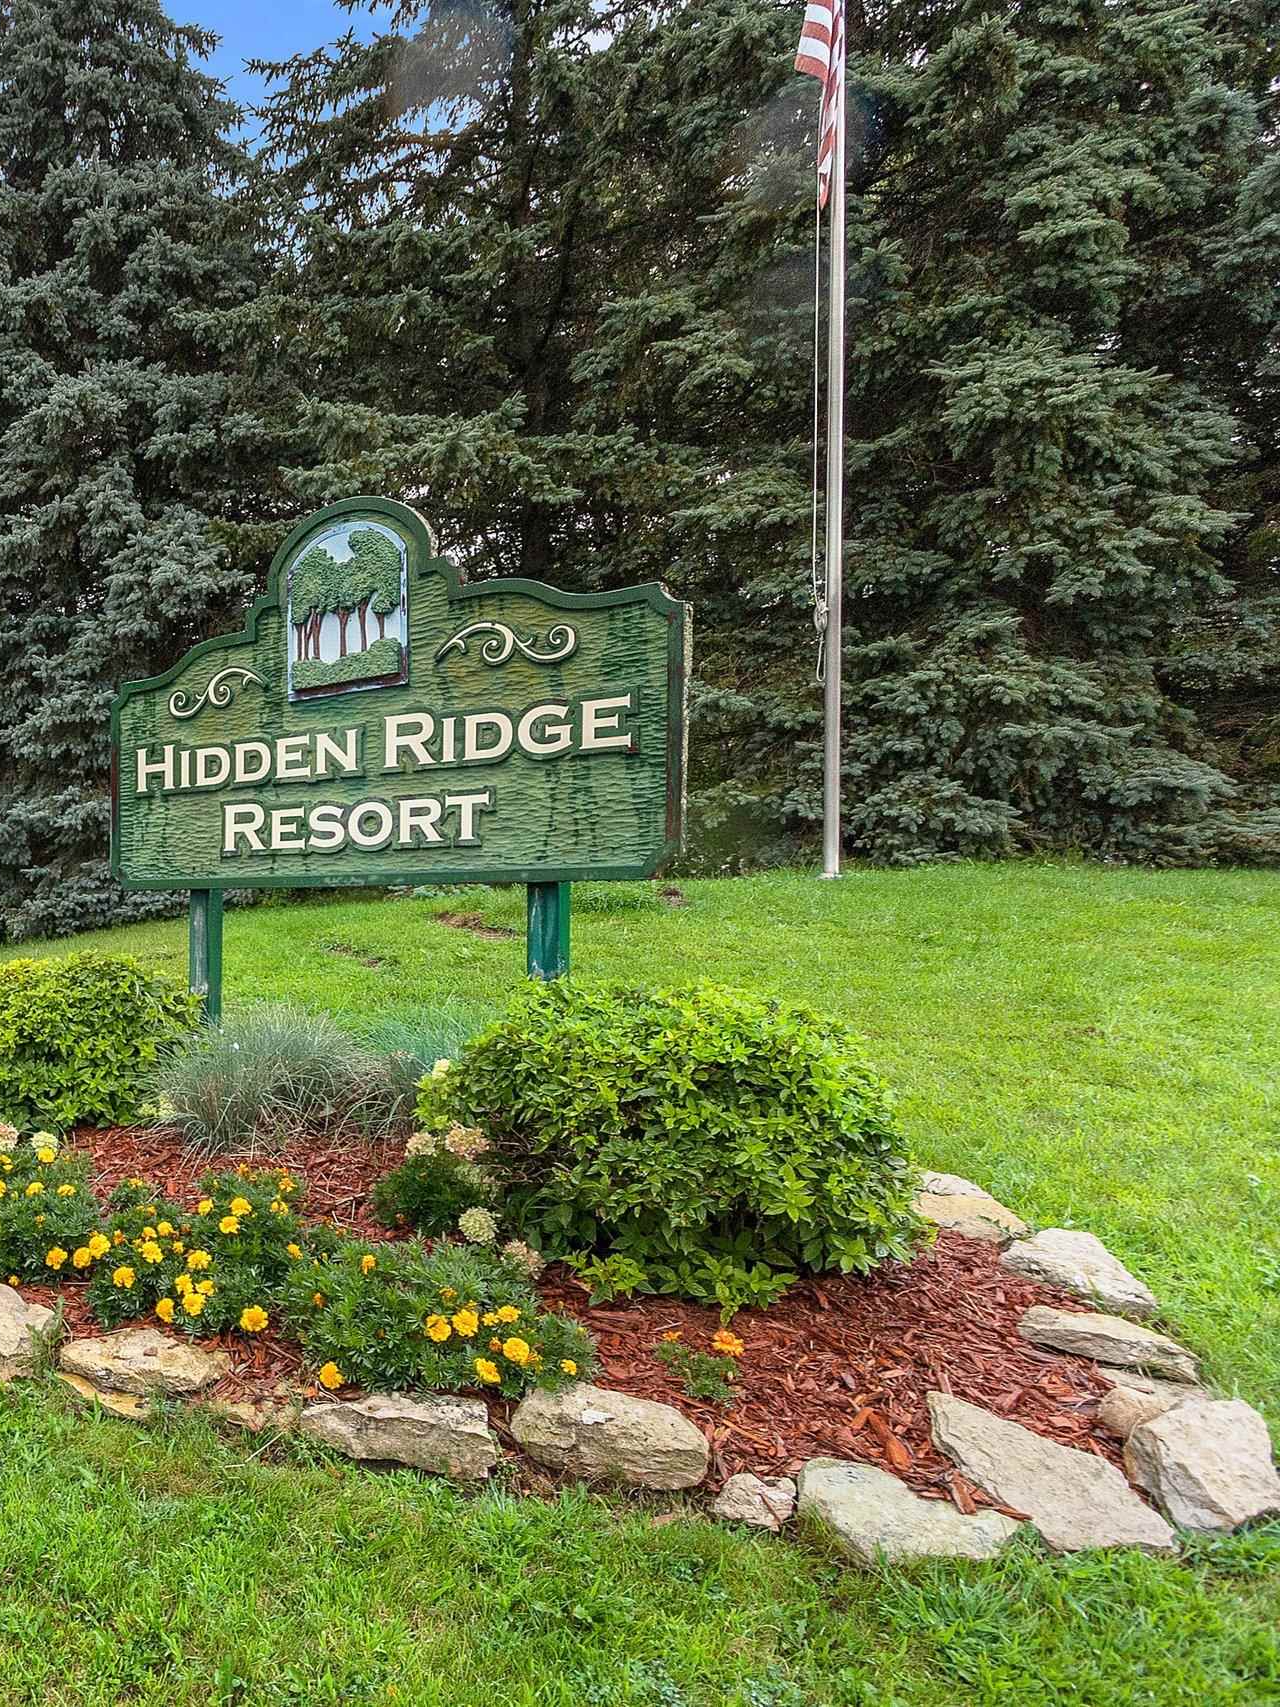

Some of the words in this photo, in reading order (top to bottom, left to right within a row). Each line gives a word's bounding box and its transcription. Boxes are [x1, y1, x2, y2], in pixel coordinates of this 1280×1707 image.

[136, 728, 358, 793] HIDDEN
[384, 694, 633, 770] RIDGE
[224, 792, 490, 853] RESORT
